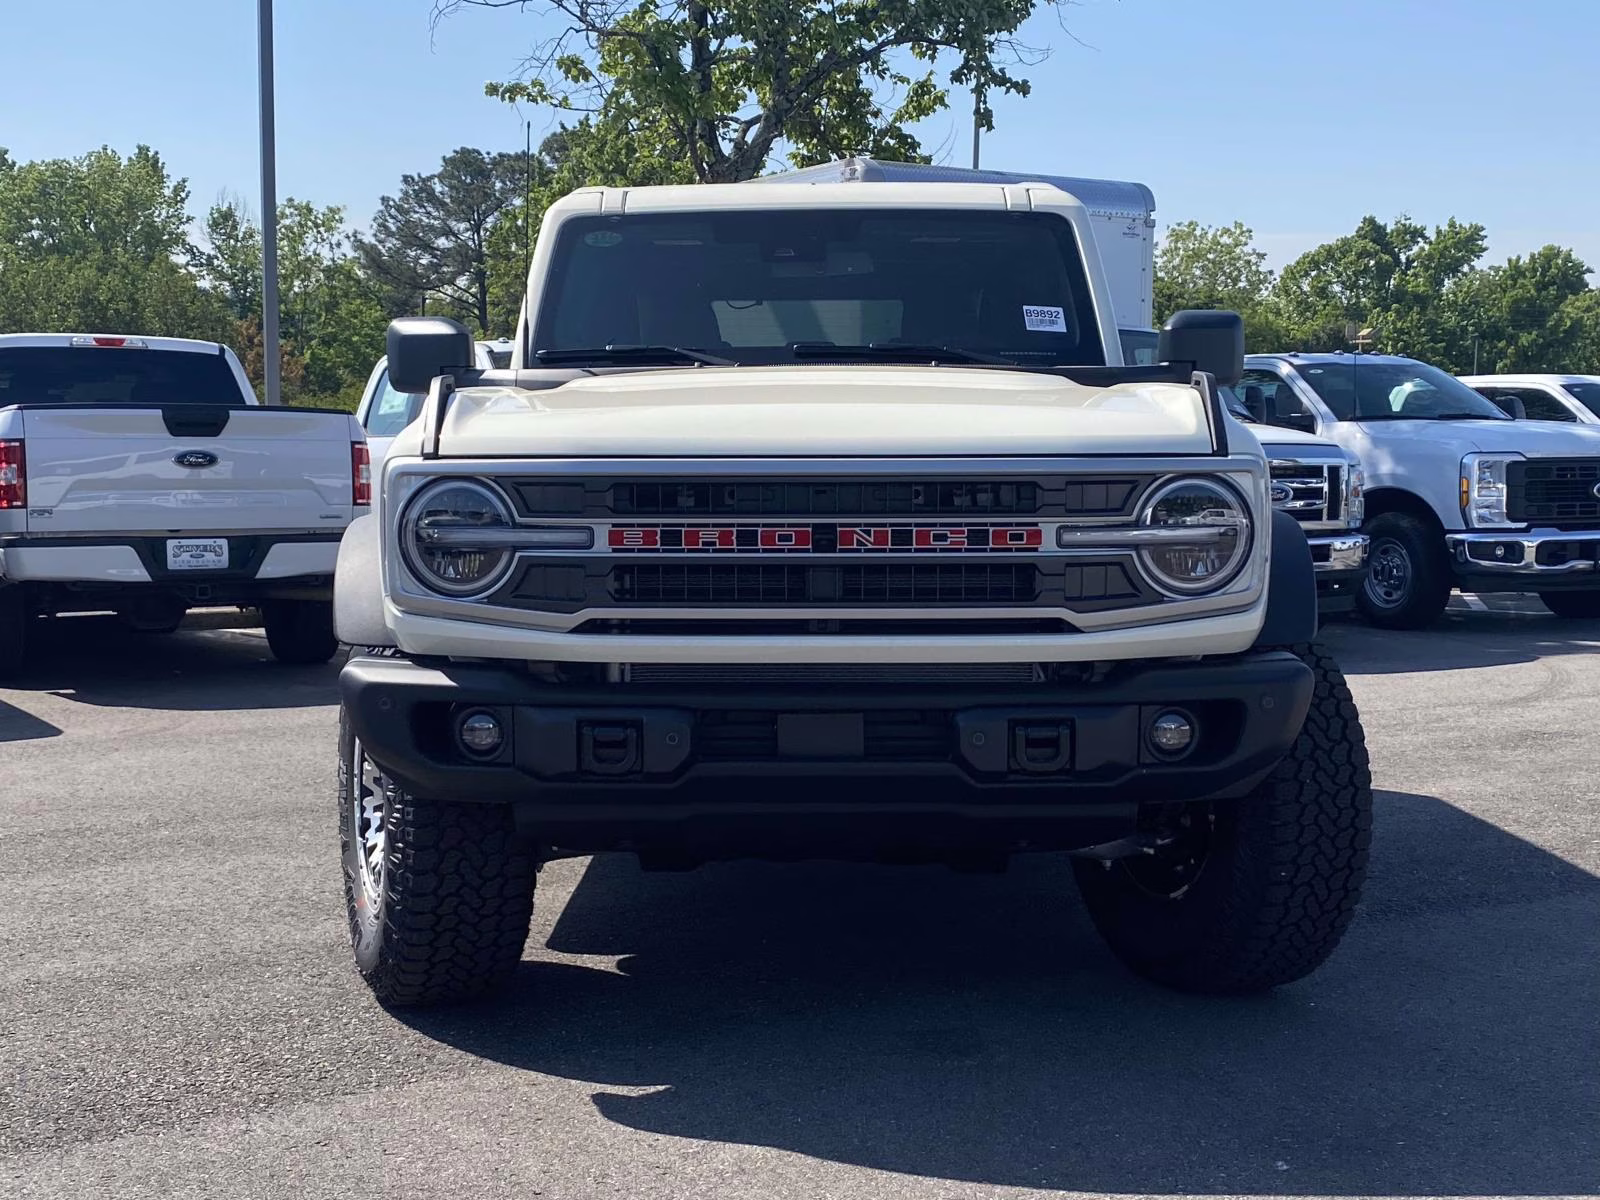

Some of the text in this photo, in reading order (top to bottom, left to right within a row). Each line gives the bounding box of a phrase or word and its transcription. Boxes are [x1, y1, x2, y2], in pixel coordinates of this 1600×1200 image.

[1025, 308, 1061, 319] B9892
[183, 453, 210, 465] Ford
[607, 527, 1043, 548] BRONCO
